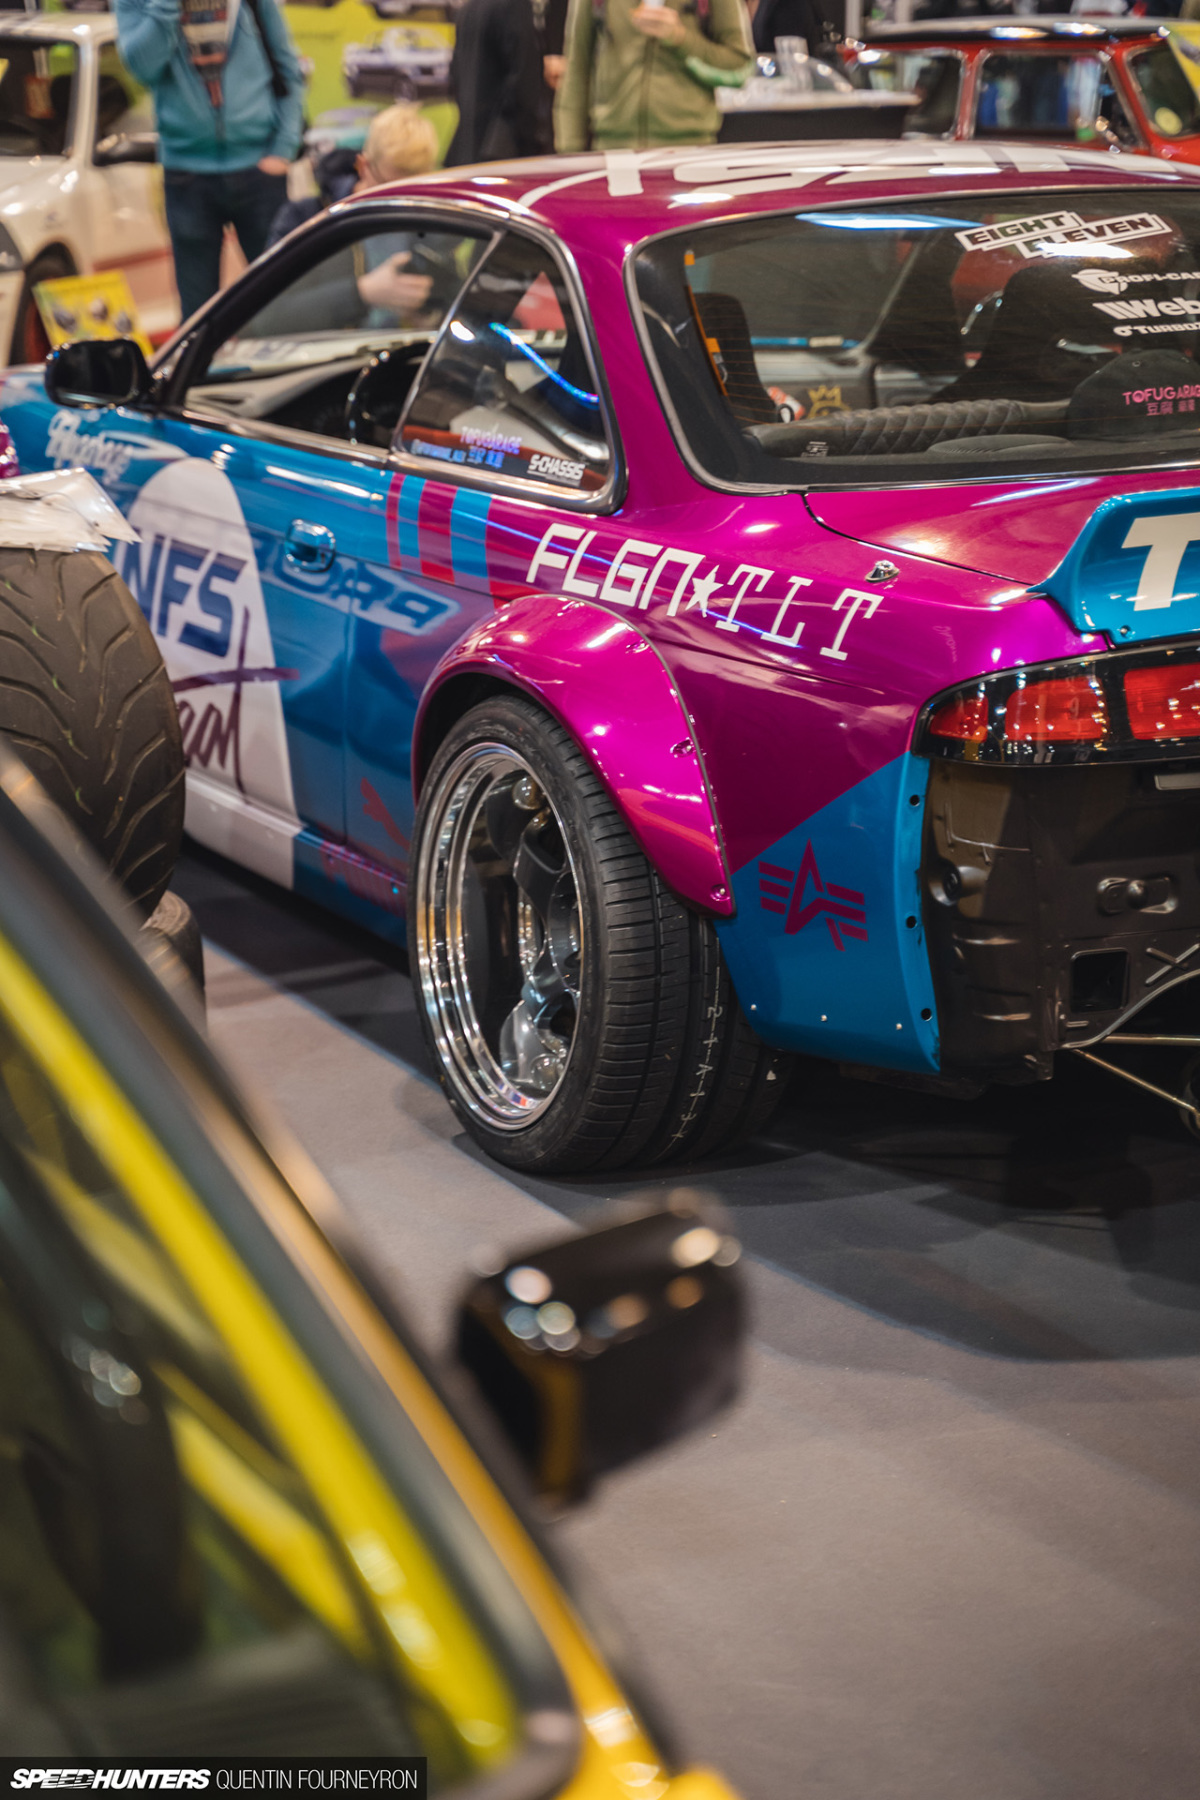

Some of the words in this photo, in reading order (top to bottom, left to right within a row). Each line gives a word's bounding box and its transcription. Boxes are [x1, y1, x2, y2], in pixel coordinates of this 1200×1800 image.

[966, 215, 1065, 245] EIGHT
[1022, 217, 1153, 255] ELEVEN
[528, 454, 586, 480] S-CHASSIS
[120, 527, 247, 658] NFS
